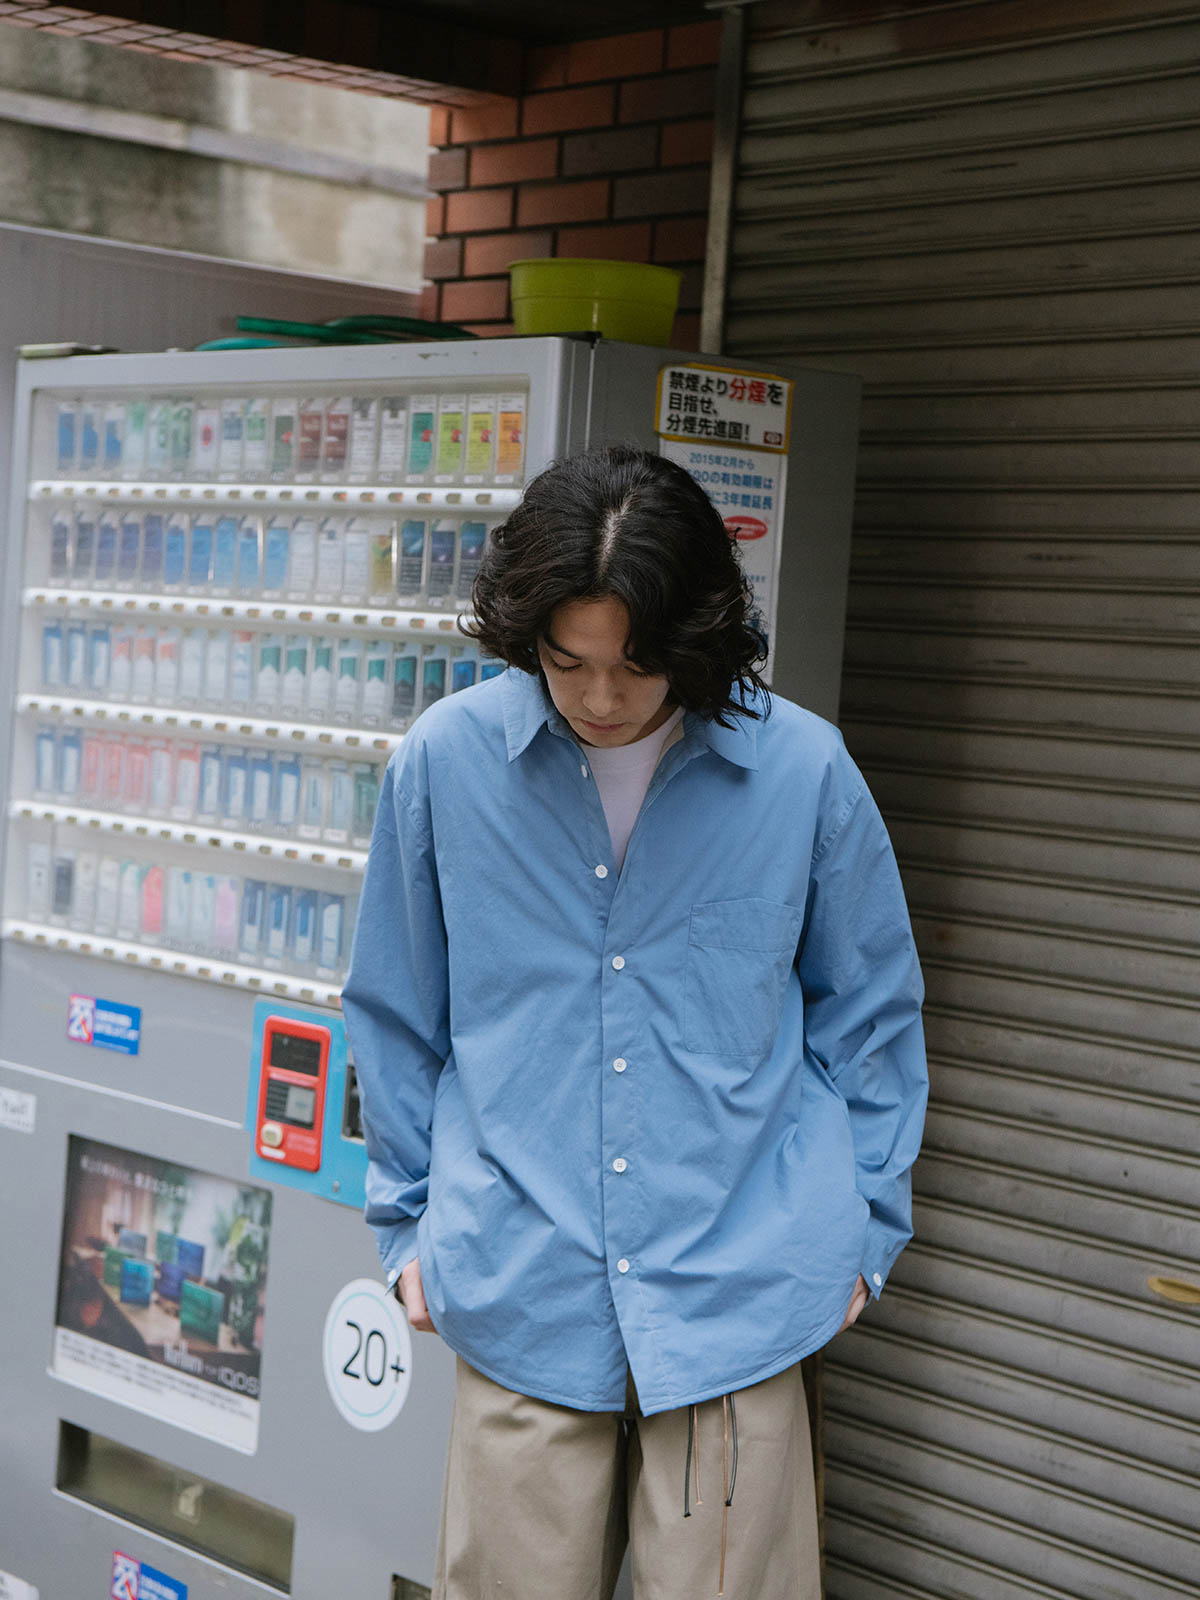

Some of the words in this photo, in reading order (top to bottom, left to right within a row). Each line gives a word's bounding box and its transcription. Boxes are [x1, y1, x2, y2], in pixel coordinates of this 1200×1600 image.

[689, 452, 756, 471] 2015年2月から
[343, 1320, 405, 1387] 20+
